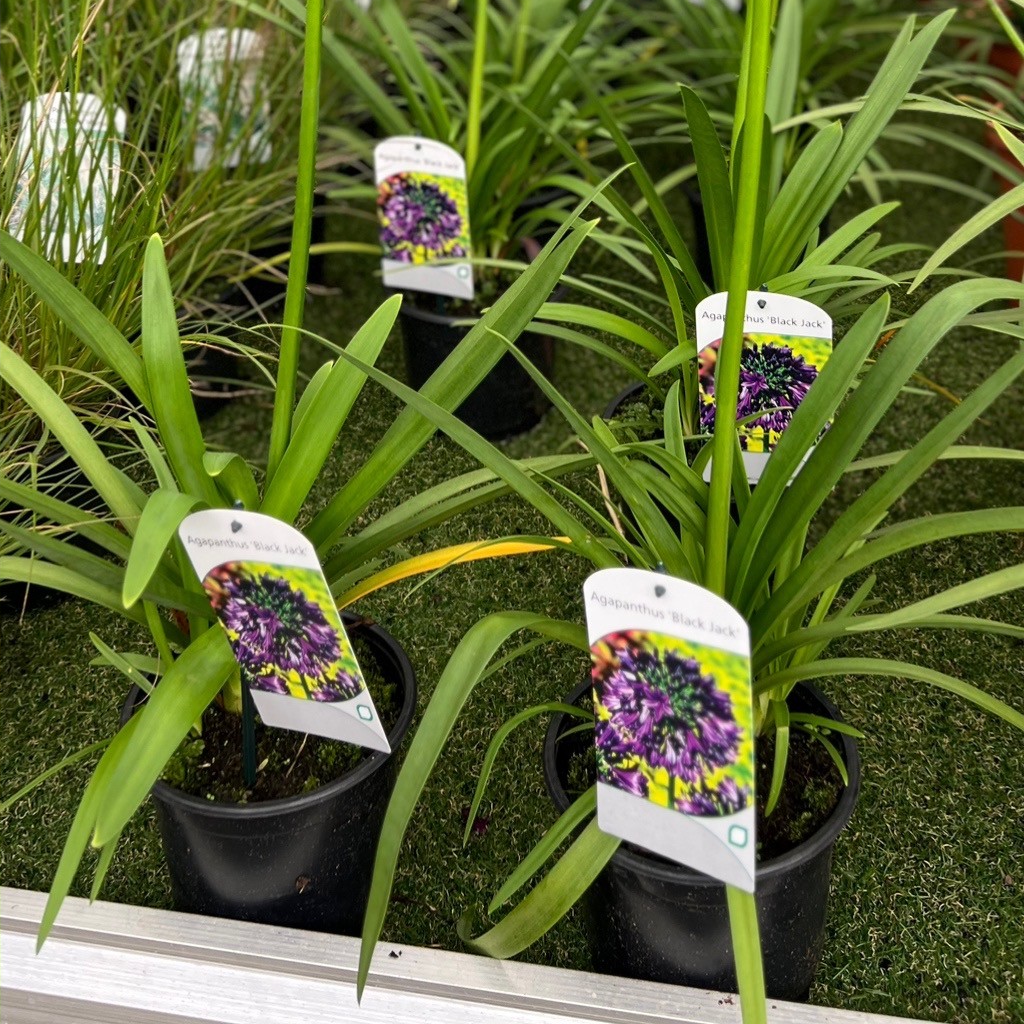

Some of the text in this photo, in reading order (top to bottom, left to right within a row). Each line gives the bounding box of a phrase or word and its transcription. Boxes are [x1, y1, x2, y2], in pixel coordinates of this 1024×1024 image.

[701, 311, 826, 329] Agaphus 'Black Jack'
[187, 535, 249, 550] Agapanthus
[250, 540, 281, 553] 'Black
[591, 590, 741, 638] Agapanthus 'Black Jack'
